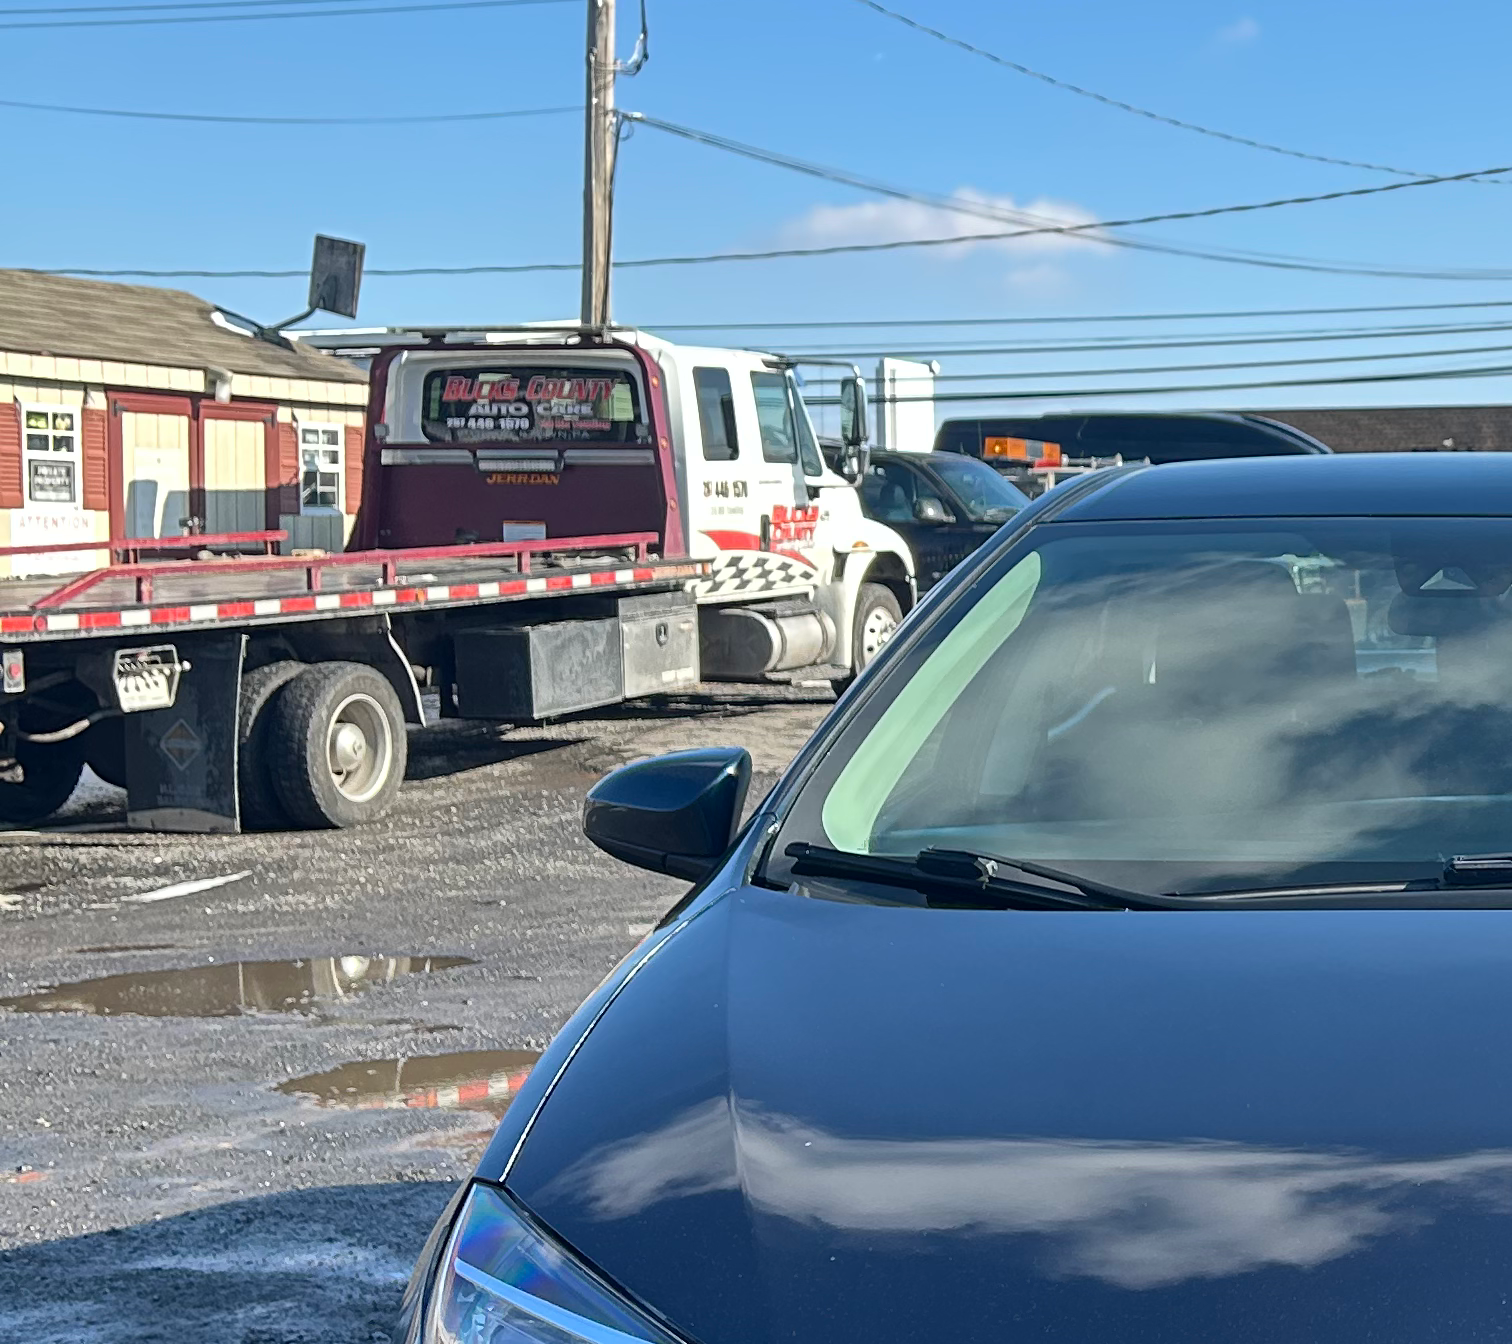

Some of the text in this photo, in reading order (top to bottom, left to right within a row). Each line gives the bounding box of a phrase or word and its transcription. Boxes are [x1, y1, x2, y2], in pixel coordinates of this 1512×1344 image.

[443, 376, 620, 401] BUCKS COUNTY
[468, 402, 593, 417] AUTO CARE
[19, 516, 89, 531] ATTENTION
